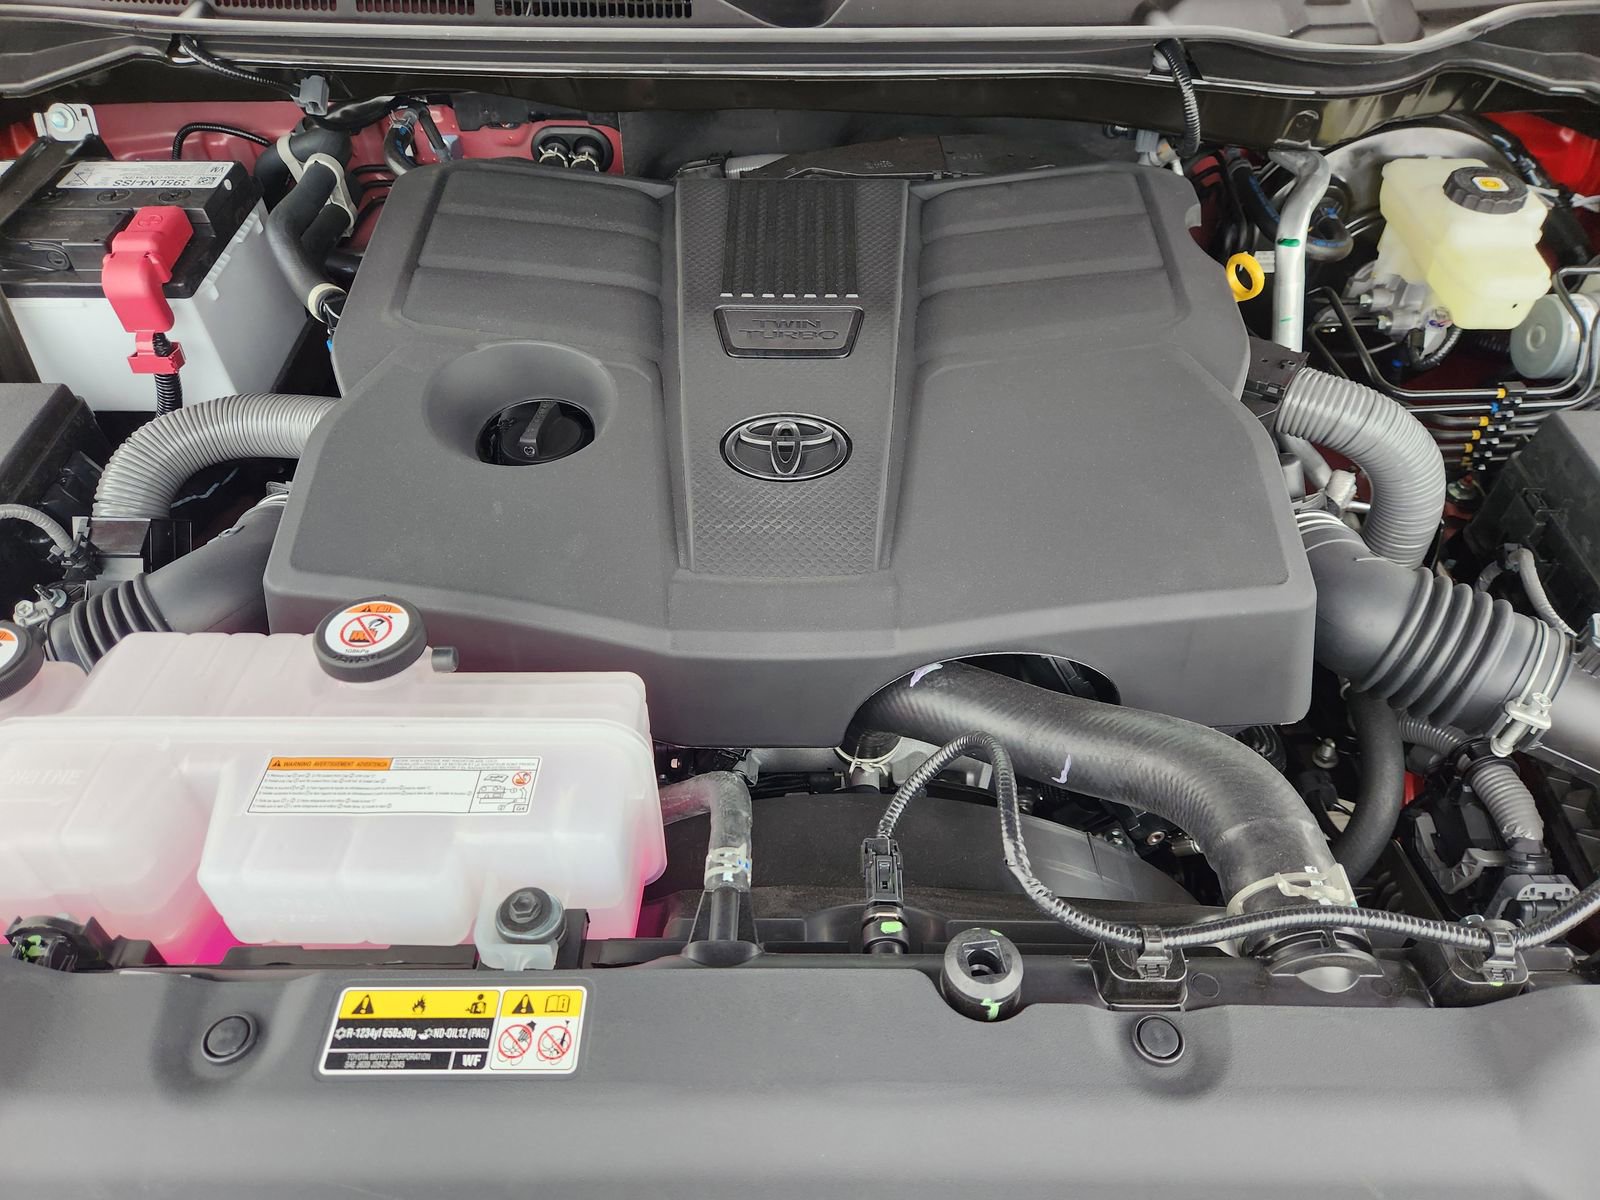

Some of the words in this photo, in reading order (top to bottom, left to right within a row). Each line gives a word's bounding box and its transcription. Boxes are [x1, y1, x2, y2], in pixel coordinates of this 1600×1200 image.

[752, 319, 821, 329] TWIN
[739, 330, 839, 340] TURBO
[467, 1027, 490, 1040] (PAG)
[462, 1054, 482, 1067] WF
